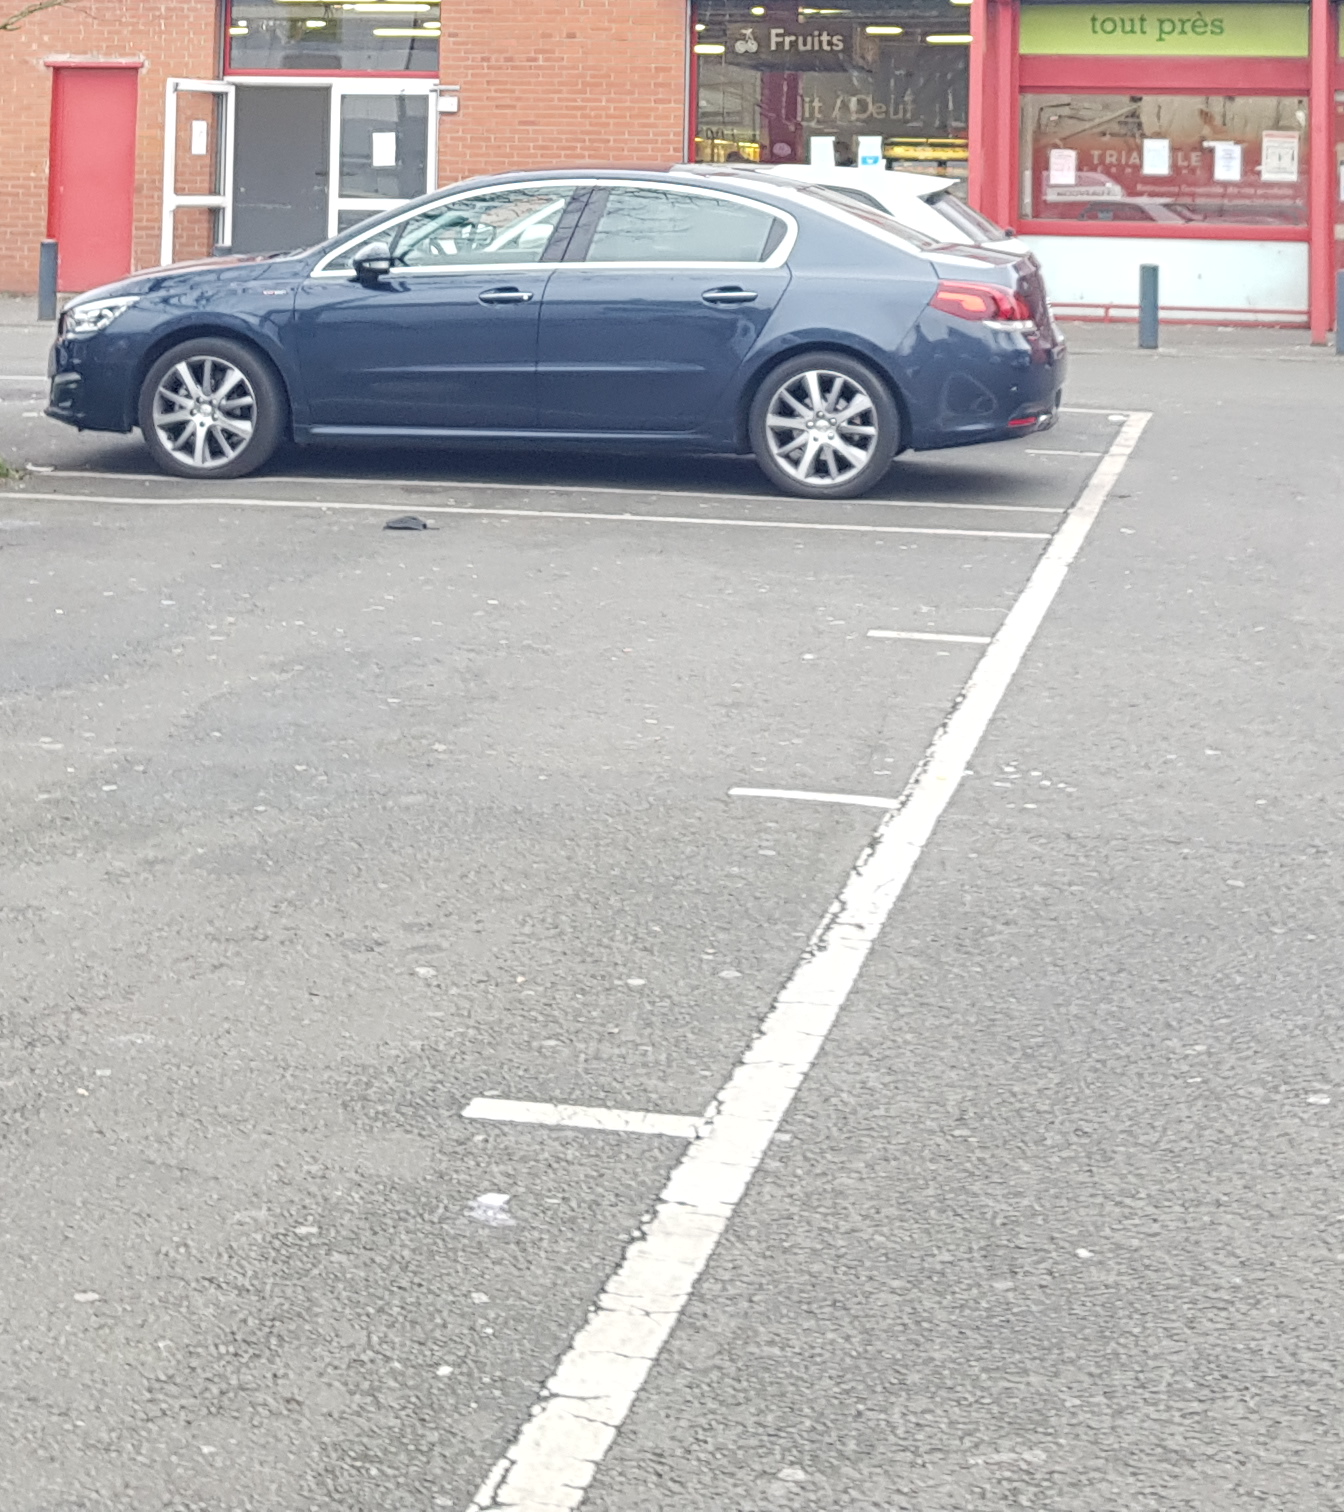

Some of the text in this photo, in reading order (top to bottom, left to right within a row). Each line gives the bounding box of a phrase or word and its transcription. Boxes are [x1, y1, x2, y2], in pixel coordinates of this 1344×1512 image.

[1090, 11, 1225, 42] tout près
[769, 27, 844, 52] Fruits
[1090, 149, 1203, 167] TRIALE
